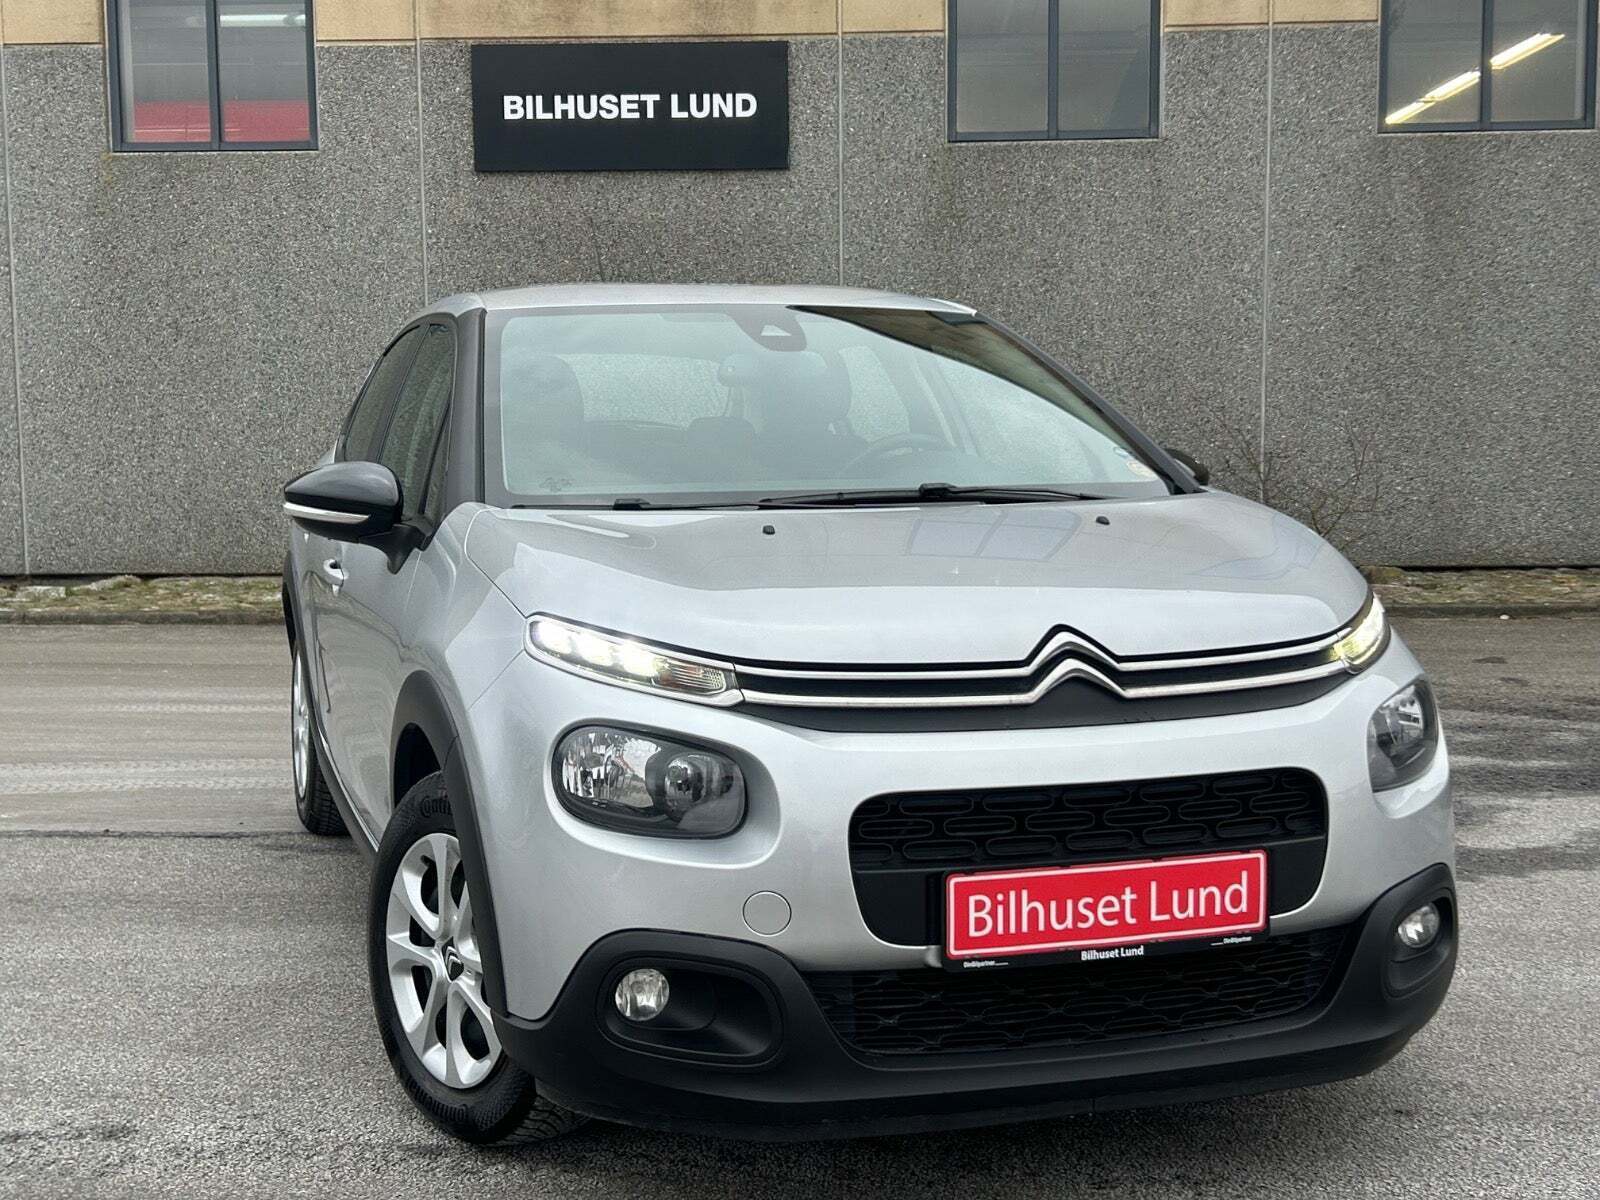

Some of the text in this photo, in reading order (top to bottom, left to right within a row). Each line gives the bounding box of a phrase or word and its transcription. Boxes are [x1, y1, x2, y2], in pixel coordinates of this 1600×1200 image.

[503, 92, 758, 120] BILHUSET LUND
[967, 870, 1249, 938] Bilhuset Lund
[1081, 944, 1145, 961] Bilhuset Lund
